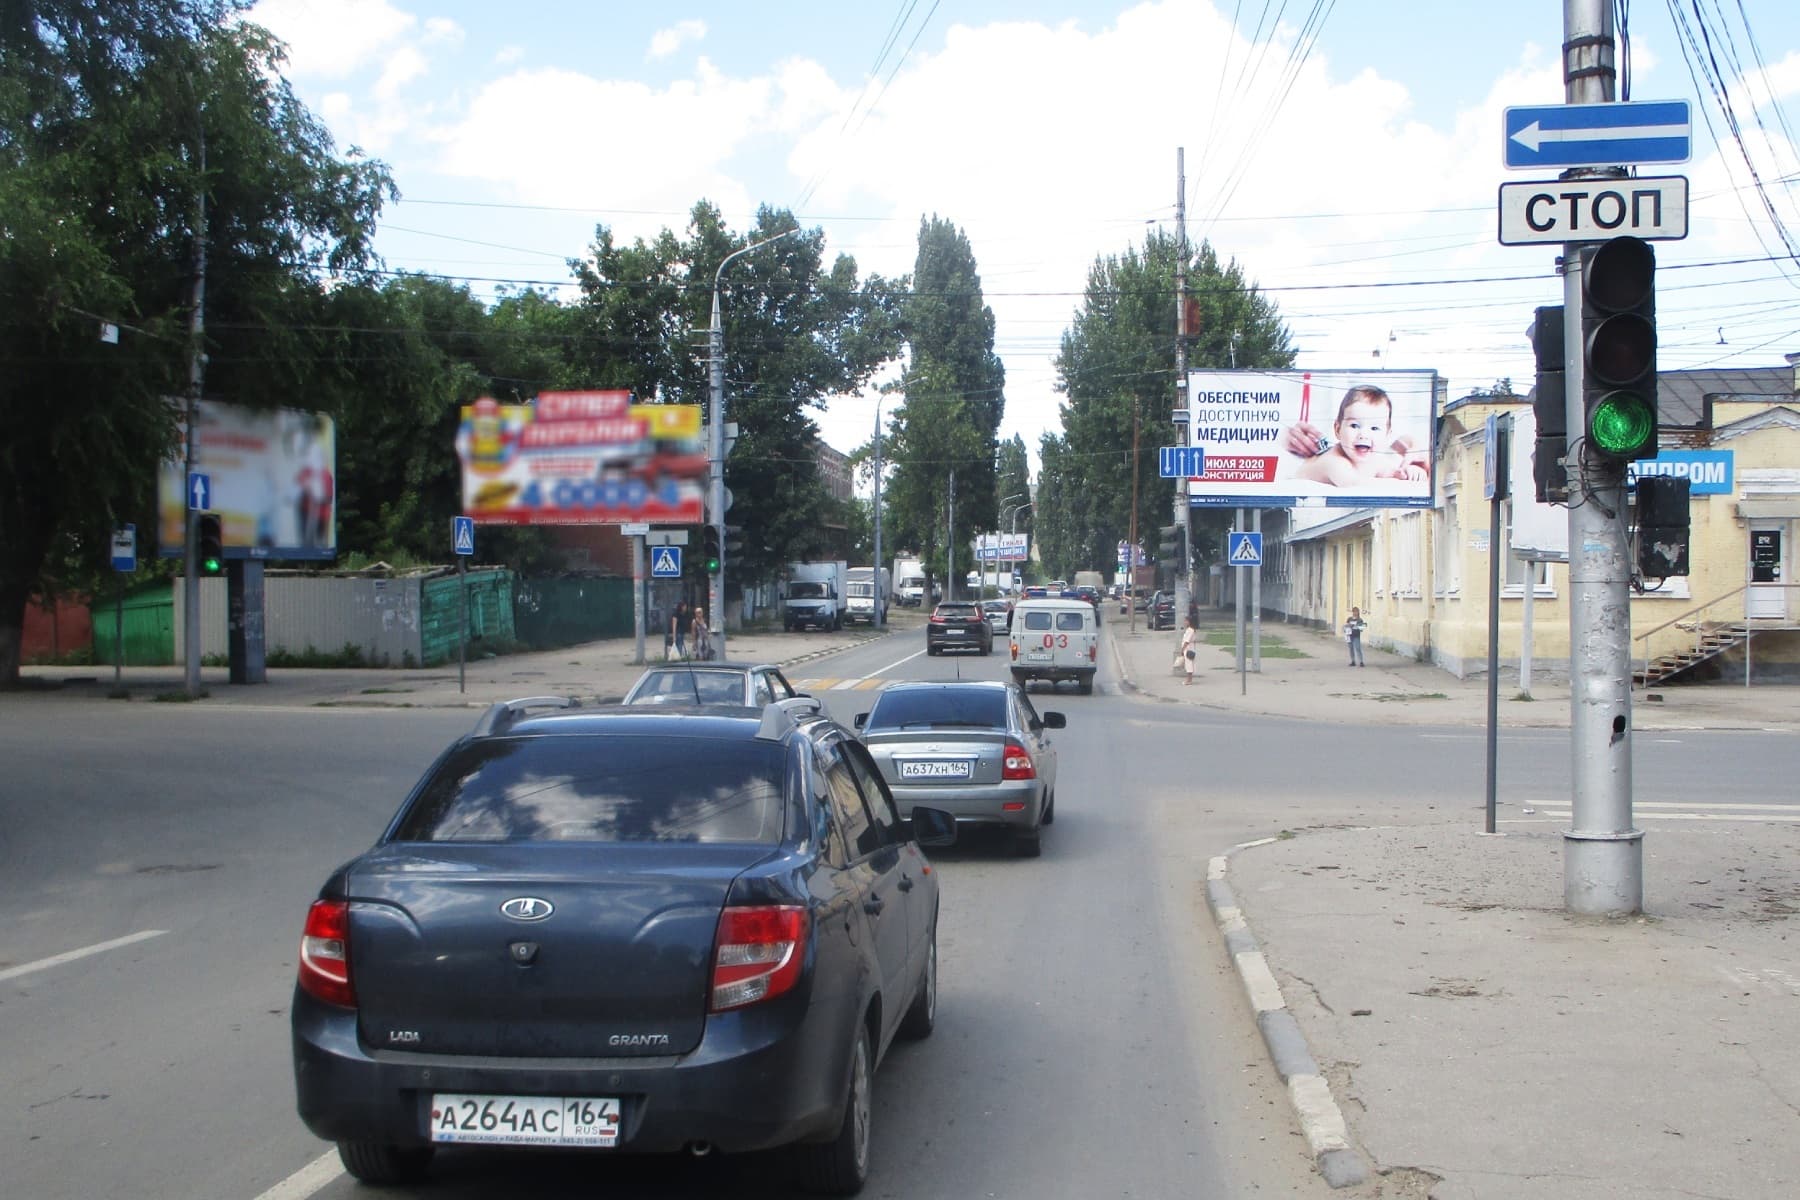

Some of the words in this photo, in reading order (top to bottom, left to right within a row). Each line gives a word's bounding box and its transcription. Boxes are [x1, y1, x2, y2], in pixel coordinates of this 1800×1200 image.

[1525, 189, 1662, 232] СТОП
[1198, 391, 1280, 404] ОБЕСПЕЧИМ
[1198, 409, 1280, 424] ДОСТУПНУЮ
[1197, 428, 1279, 444] МЕДИЦИНУ
[1205, 458, 1236, 469] ИЮЛЯ
[1239, 458, 1265, 469] 2020
[1198, 471, 1264, 481] ОНСТИТУЦИЯ
[1043, 633, 1068, 649] 03
[905, 763, 948, 775] А637ХН
[950, 762, 967, 772] 164
[389, 1031, 420, 1042] LADA
[609, 1034, 669, 1046] GRANTA
[440, 1100, 559, 1133] А264АС
[566, 1101, 615, 1126] 164
[575, 1126, 598, 1135] RUS
